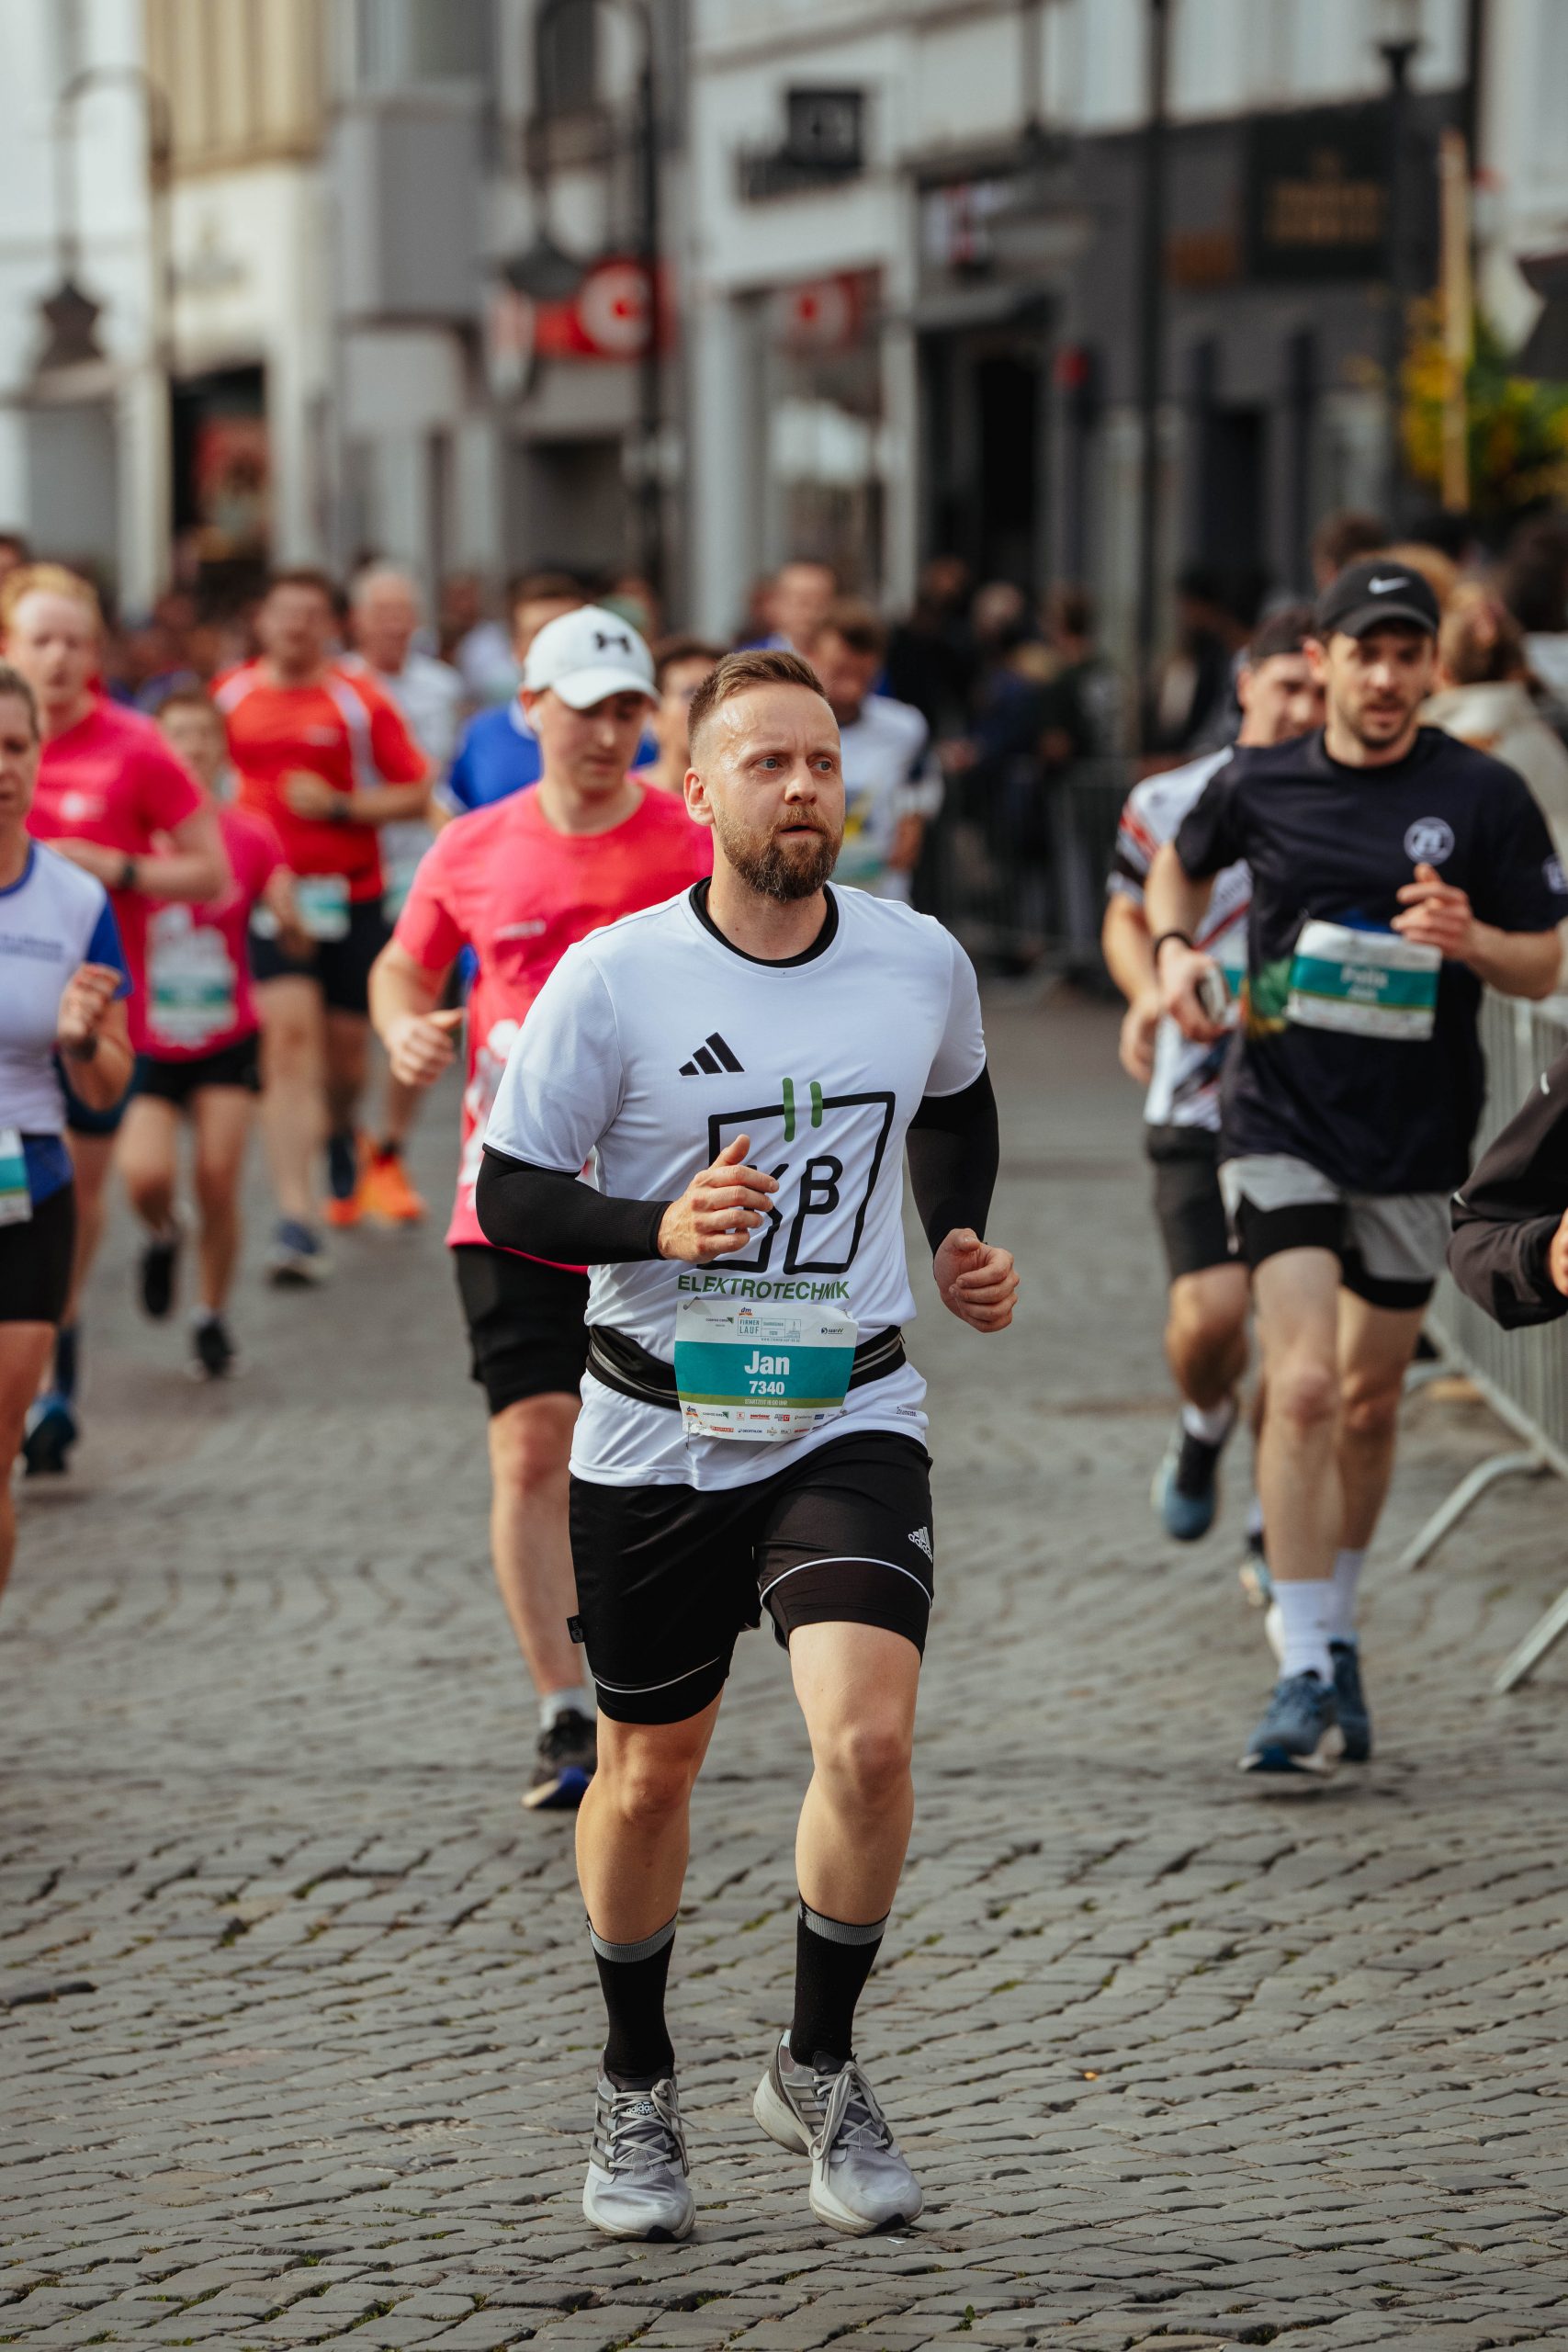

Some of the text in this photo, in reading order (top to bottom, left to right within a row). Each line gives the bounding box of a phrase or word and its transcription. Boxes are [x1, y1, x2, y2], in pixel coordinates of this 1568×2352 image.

[739, 1326, 760, 1334] LAUF
[744, 1351, 790, 1375] Jan
[749, 1380, 785, 1396] 7340
[626, 2103, 656, 2113] adidas
